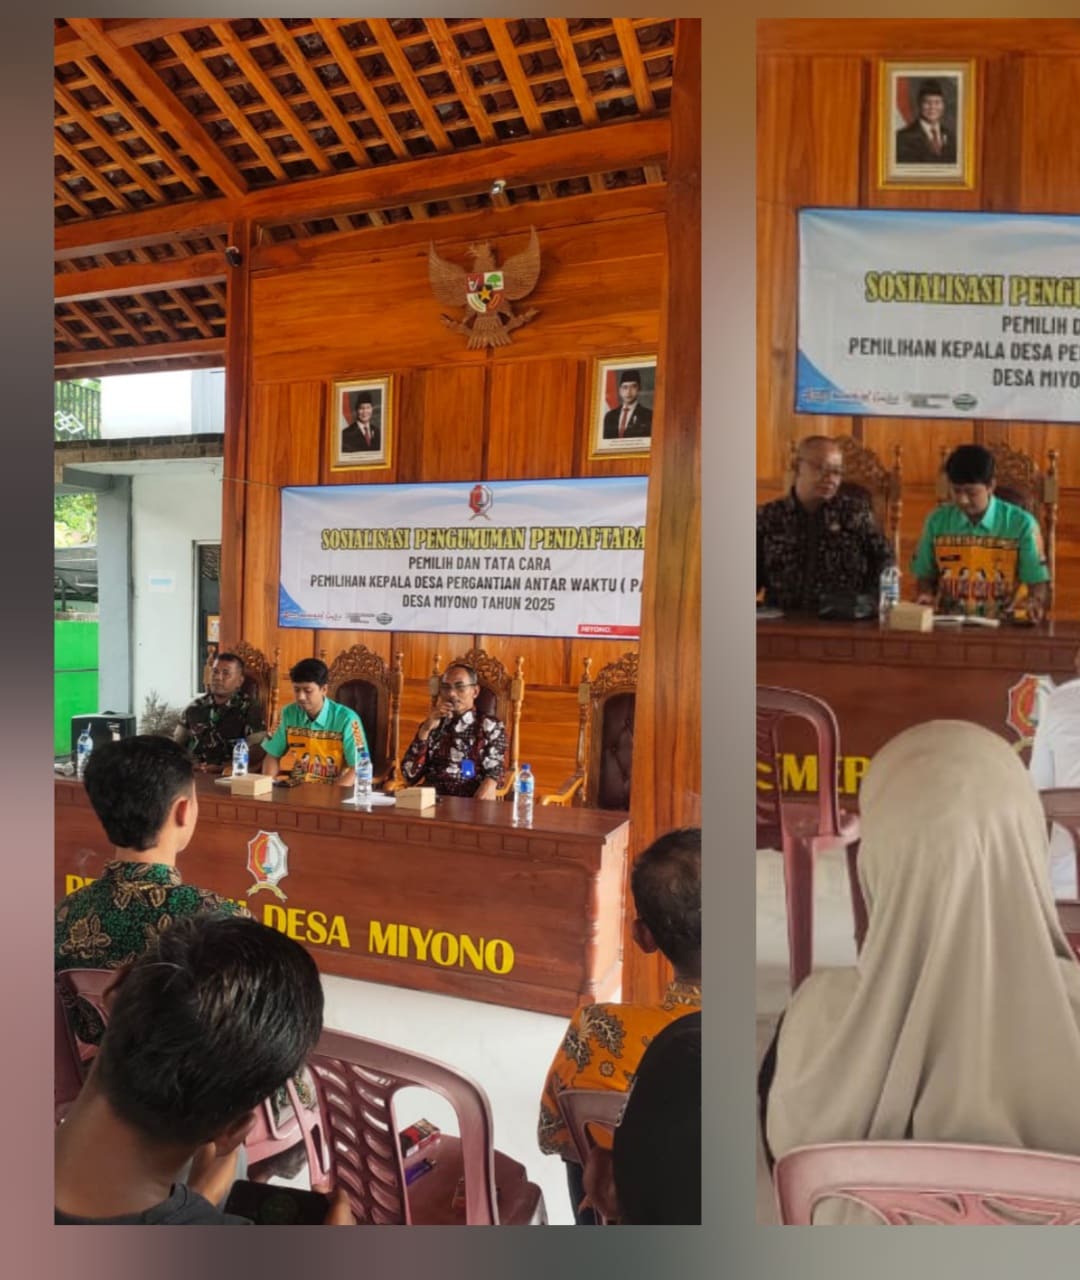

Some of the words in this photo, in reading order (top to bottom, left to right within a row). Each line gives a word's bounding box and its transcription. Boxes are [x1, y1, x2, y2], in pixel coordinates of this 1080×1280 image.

[865, 271, 1004, 306] SOSIALISASI
[1002, 315, 1067, 335] PEMILIH
[849, 337, 936, 357] PEMILIHAN
[941, 340, 1005, 360] KEPALA
[1010, 342, 1052, 361] DESA
[993, 368, 1034, 387] DESA
[322, 528, 411, 550] SOSIALISASI
[413, 527, 526, 550] PENGUMUMAN
[409, 556, 453, 570] PEMILIH
[457, 557, 480, 570] DAN
[484, 557, 515, 571] TATA
[518, 557, 551, 571] CARA
[310, 574, 366, 588] PEMILIHAN
[369, 575, 411, 589] KEPALA
[415, 576, 443, 589] DESA
[446, 576, 521, 590] PERGANTIAN
[524, 577, 566, 591] ANTAR
[570, 578, 617, 592] WAKTU
[402, 594, 431, 608] DESA
[434, 595, 477, 609] MIYONO
[482, 596, 521, 610] TAHUN
[524, 597, 555, 611] 2025
[263, 904, 350, 948] DESA
[368, 920, 515, 974] MIYONO
